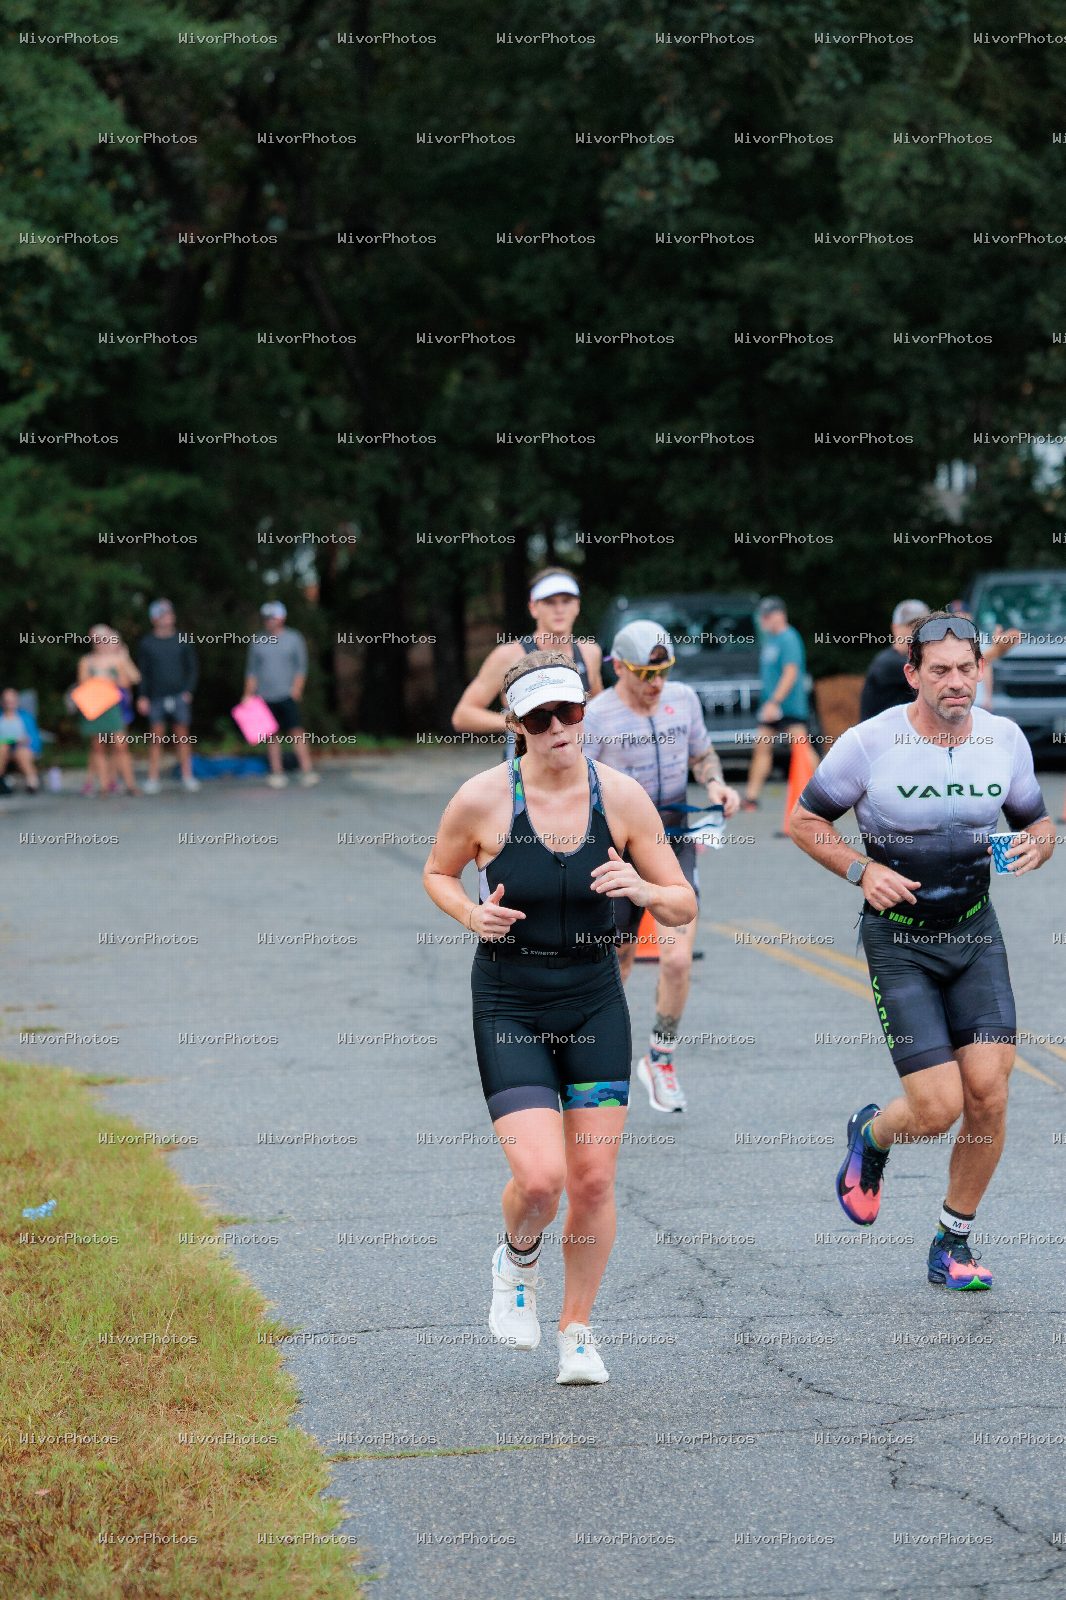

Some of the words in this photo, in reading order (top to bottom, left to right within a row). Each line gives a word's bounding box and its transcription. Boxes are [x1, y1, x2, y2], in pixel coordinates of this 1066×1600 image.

[897, 783, 1002, 799] VARLO
[889, 911, 914, 925] VARLO
[873, 976, 894, 1048] VARLO
